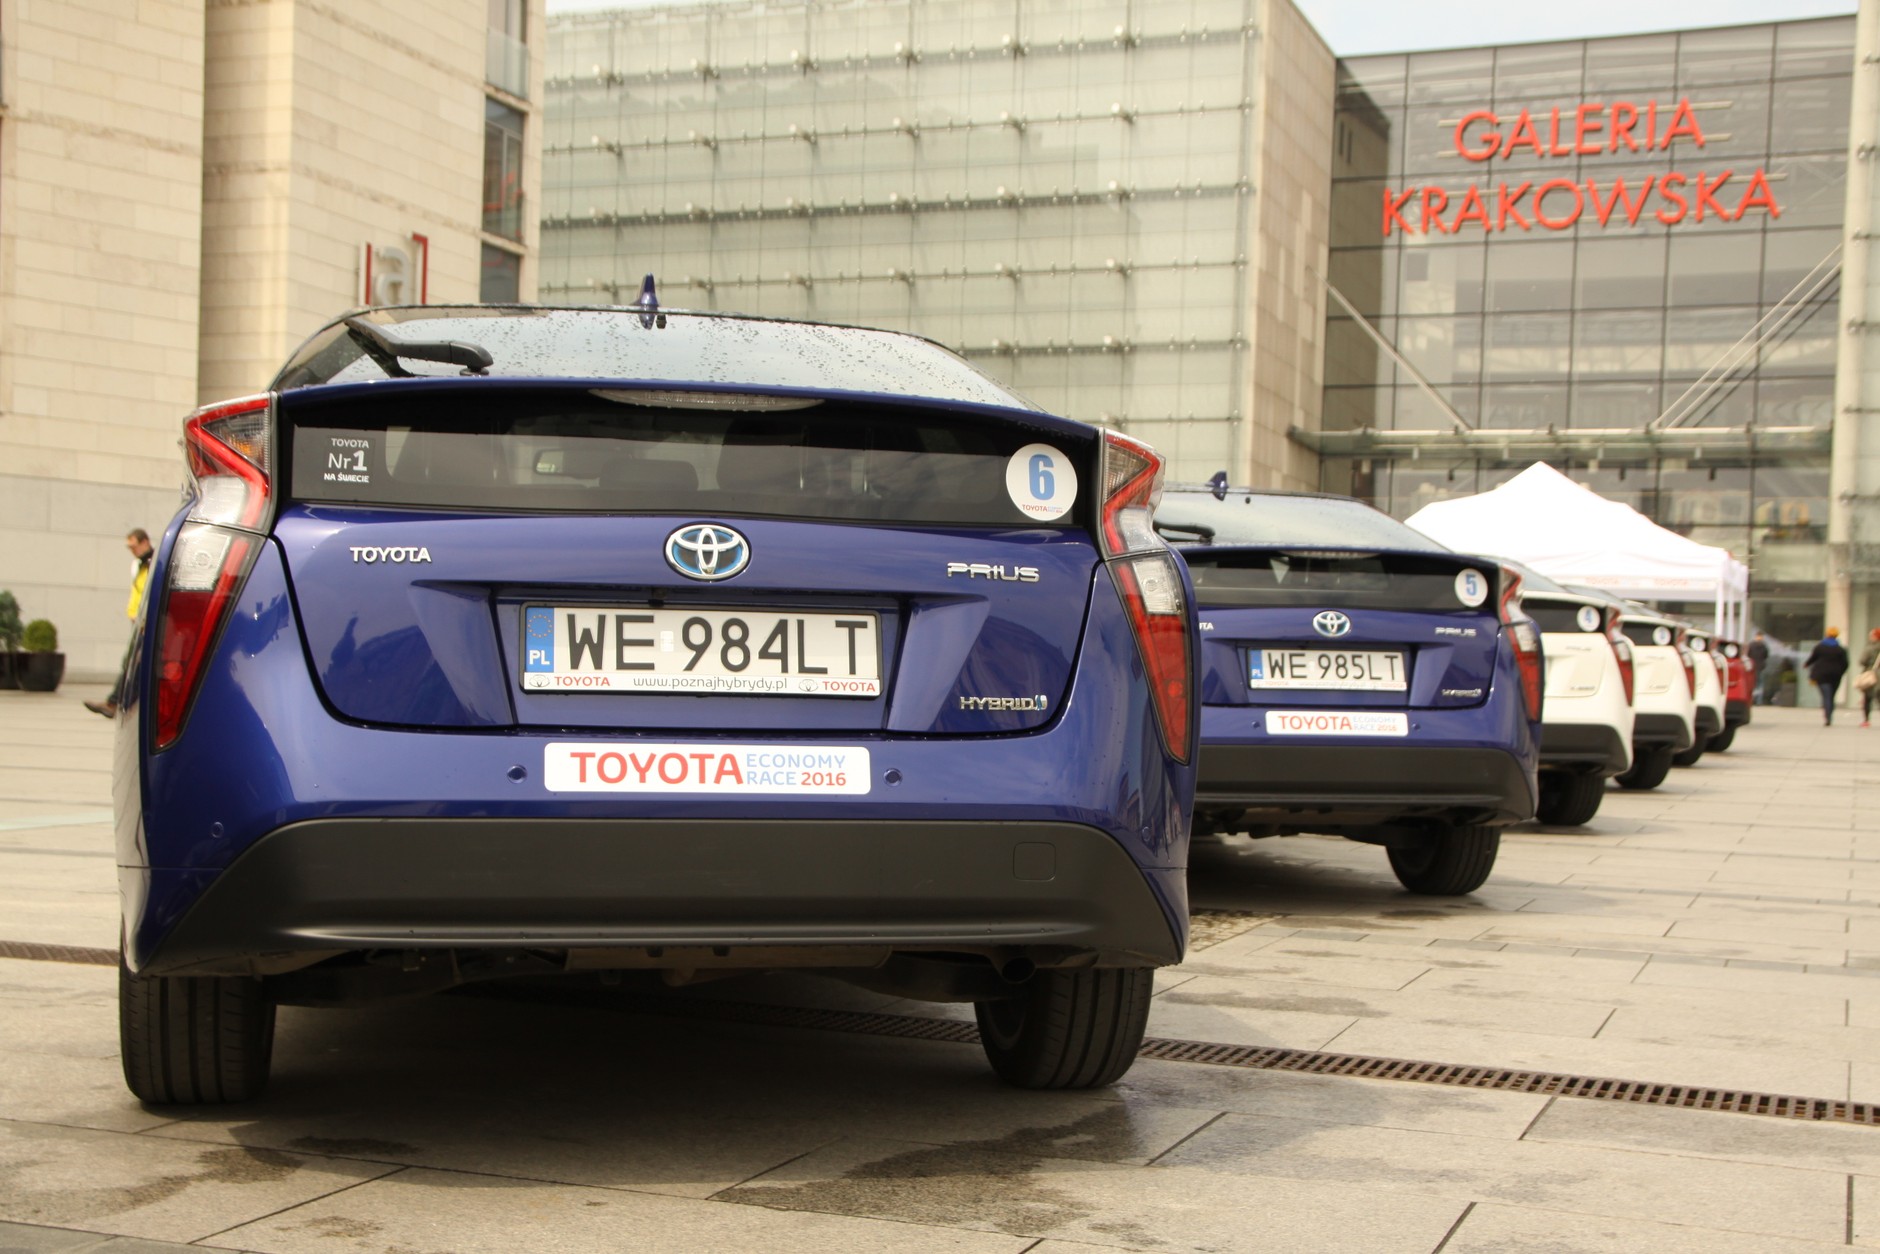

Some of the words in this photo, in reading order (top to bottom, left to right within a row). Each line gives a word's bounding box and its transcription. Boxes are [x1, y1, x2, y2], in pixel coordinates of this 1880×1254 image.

[1453, 97, 1706, 161] GALERIA
[1382, 168, 1781, 236] KRAKOWSKA
[331, 438, 369, 448] TOYOTA
[324, 472, 336, 481] NA
[337, 472, 369, 483] ŚWIECIE
[1029, 454, 1055, 500] 6
[1022, 504, 1047, 512] TOYOTA
[350, 547, 432, 563] TOYOTA
[947, 562, 1040, 583] PRIUS
[1465, 573, 1477, 596] 5
[567, 613, 655, 671] WE
[681, 616, 868, 676] 984LT
[529, 650, 550, 665] PL
[1268, 653, 1307, 679] WE
[1318, 654, 1399, 680] 985LT
[554, 676, 610, 687] TOYOTA
[633, 676, 788, 691] www.poznajhybrydy.pl
[822, 681, 876, 693] TOYOTA
[960, 696, 1036, 711] HYBRID
[1278, 716, 1352, 731] TOYOTA
[570, 752, 743, 785] TOYOTA
[746, 753, 847, 769] ECONOMY
[747, 771, 797, 785] RACE
[801, 772, 847, 786] 2016
